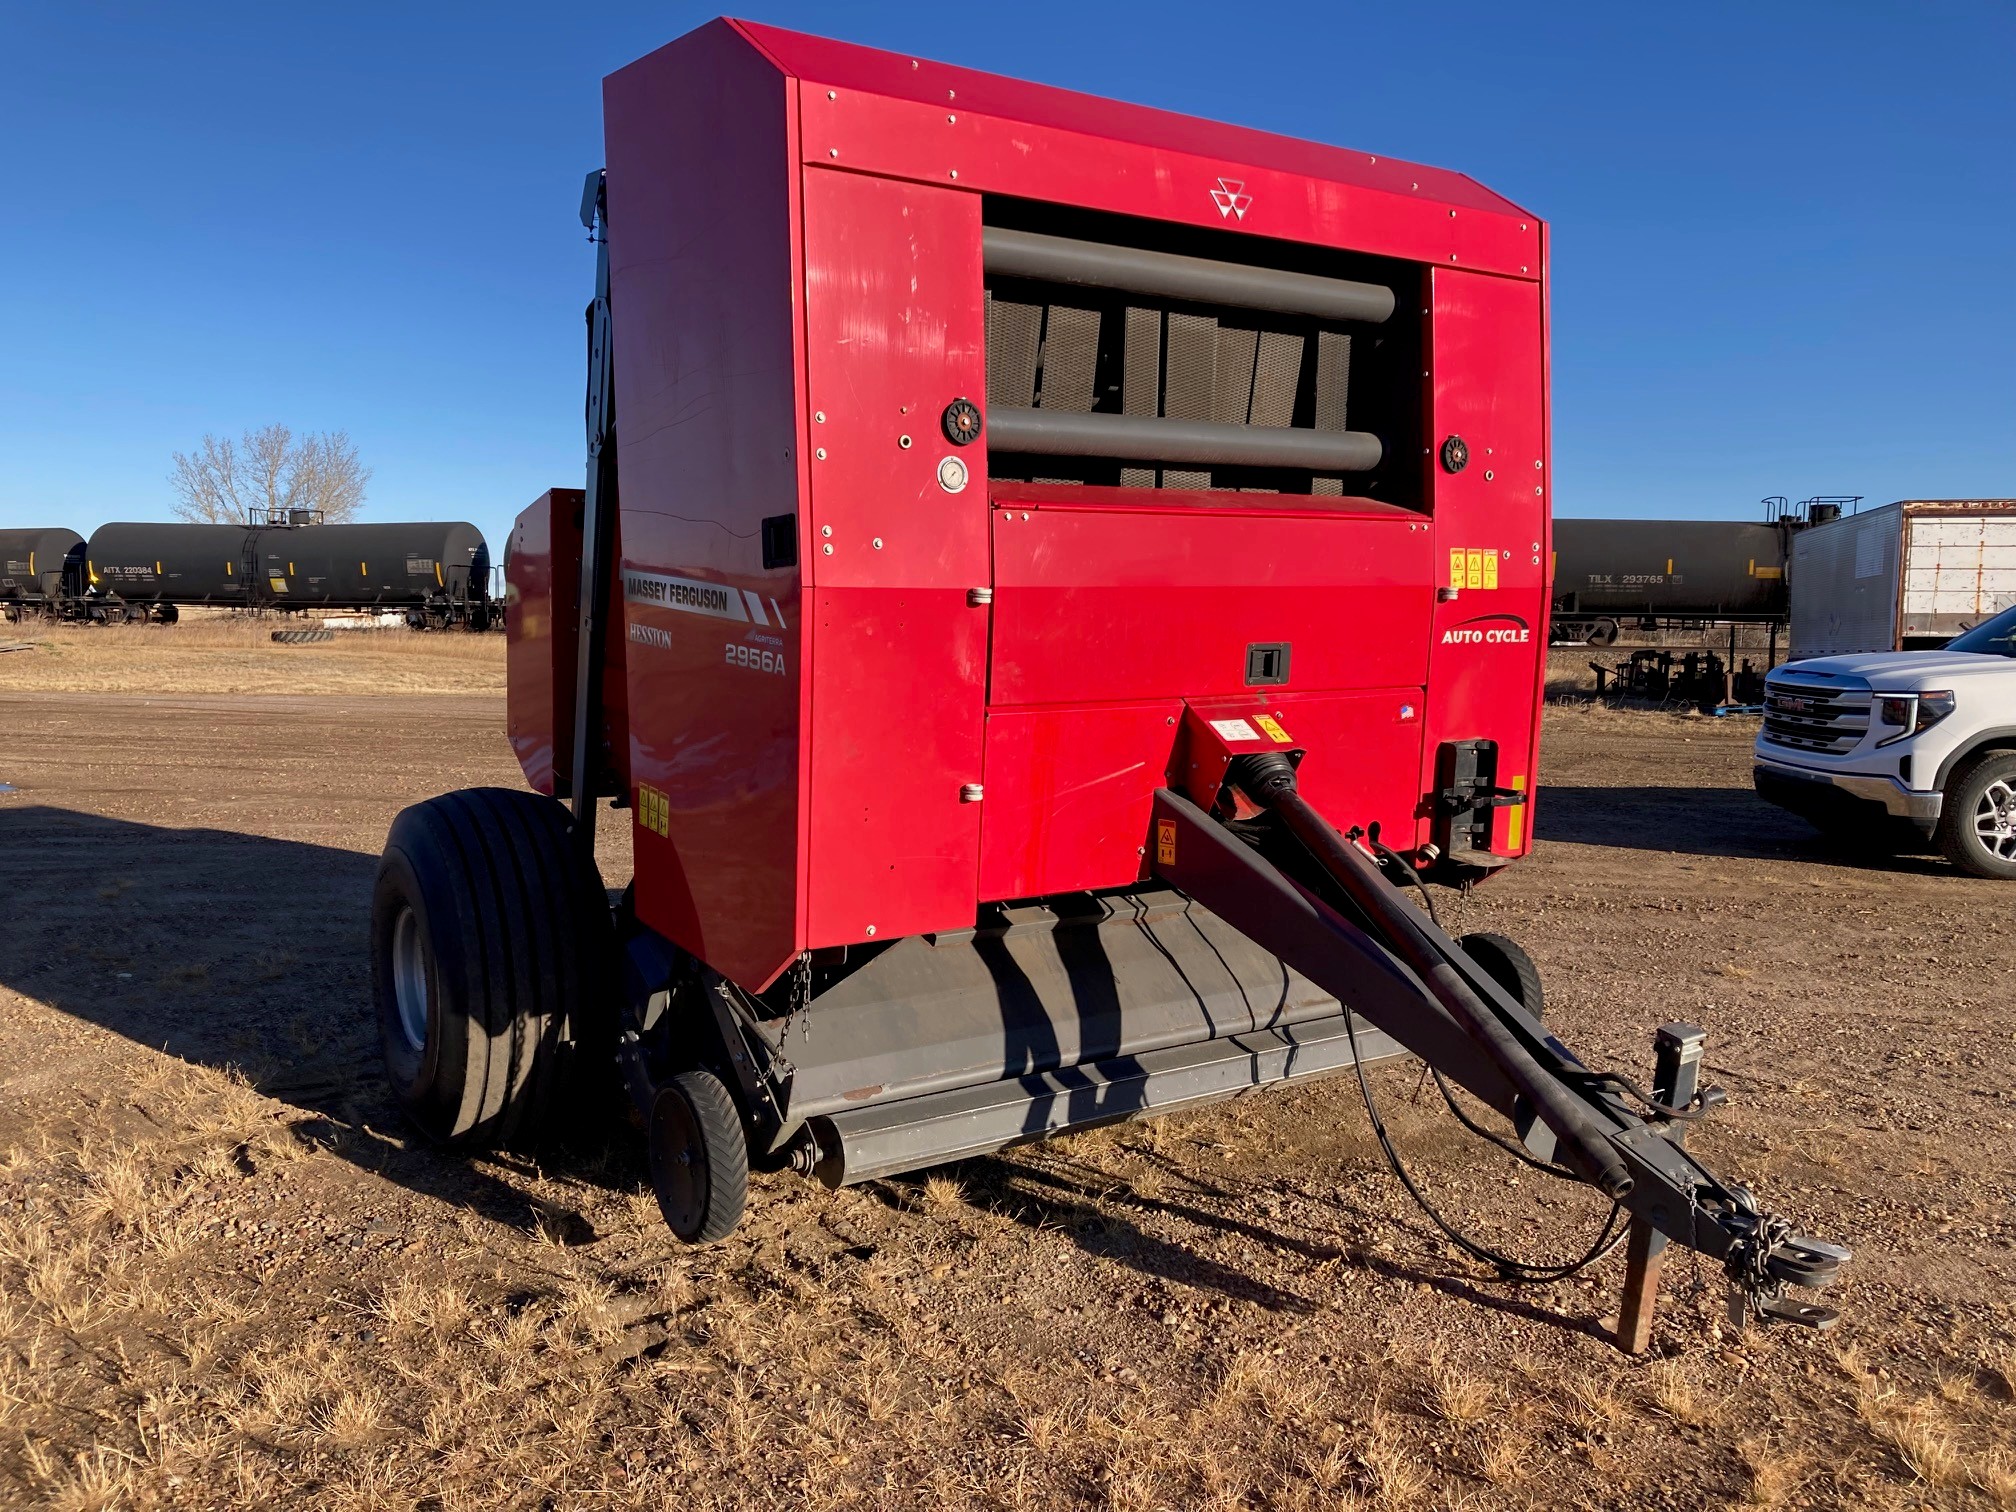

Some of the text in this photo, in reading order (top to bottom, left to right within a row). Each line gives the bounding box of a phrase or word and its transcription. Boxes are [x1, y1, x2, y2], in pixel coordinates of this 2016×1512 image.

[103, 566, 152, 574] AITX 220384
[1589, 574, 1612, 584] TILX
[1622, 575, 1664, 584] 293765
[628, 578, 727, 611] MASSEY FERGUSON
[630, 624, 671, 649] HESSTON
[755, 635, 783, 646] AGRITERRA
[1441, 629, 1530, 644] AUTO CYCLE
[725, 643, 786, 676] 2956A
[1778, 697, 1814, 712] GMC
